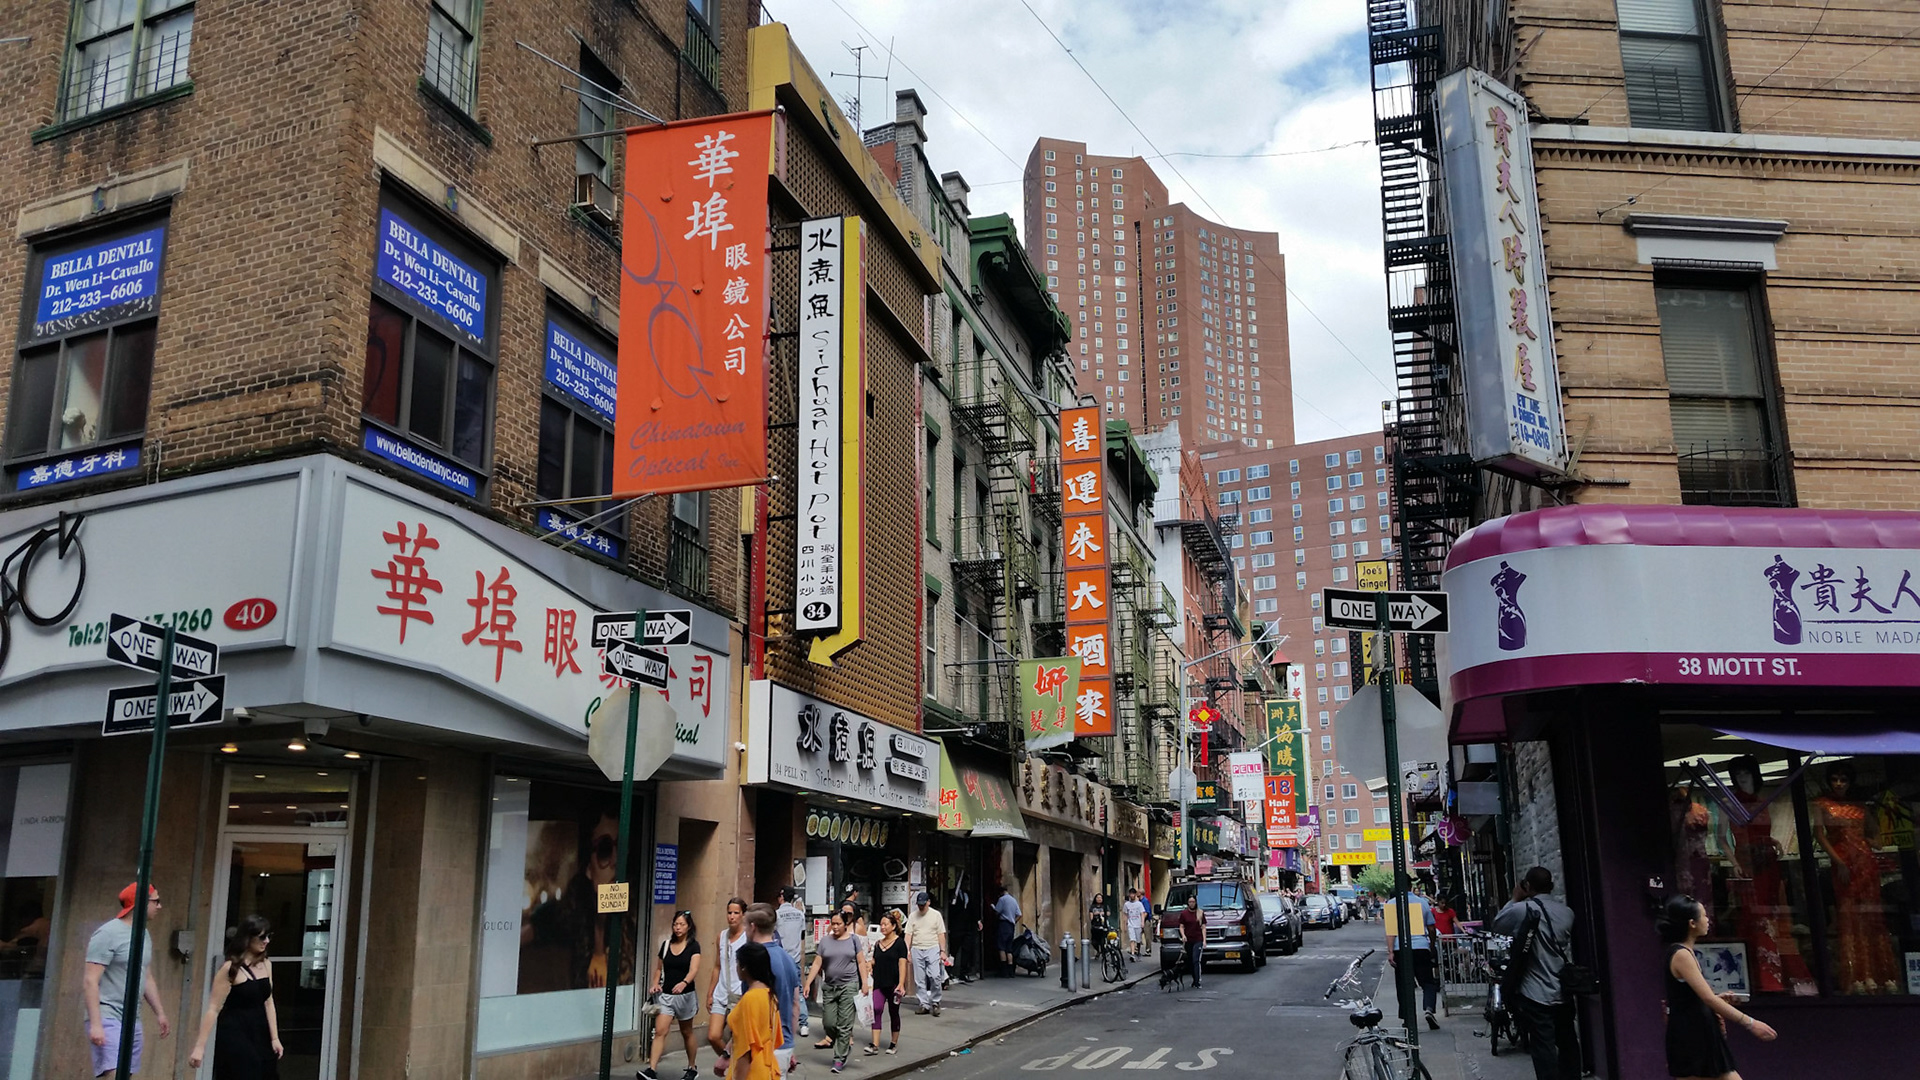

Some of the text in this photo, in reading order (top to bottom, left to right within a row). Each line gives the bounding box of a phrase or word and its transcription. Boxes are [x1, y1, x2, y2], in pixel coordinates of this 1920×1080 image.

[51, 238, 153, 279] BELLA DENTAL
[384, 240, 401, 262] Dr.
[403, 252, 427, 279] Wen
[388, 219, 480, 293] BELLA DENTAL
[807, 226, 838, 321] 水煮魚
[45, 285, 61, 298] Dr.
[65, 278, 89, 293] Wen
[51, 279, 143, 315] 212-233-6606
[392, 265, 474, 327] 212-233-6606
[722, 242, 751, 376] 眼鏡公司
[553, 330, 582, 361] BELLA
[550, 347, 562, 364] Dr.
[563, 356, 581, 378] Wen
[556, 368, 614, 415] 212-233-6606
[630, 420, 747, 450] Chinatown
[808, 330, 830, 540] Sichuan Hot Pot
[30, 449, 126, 484] 嘉德牙科
[376, 434, 469, 489] www.belladentalnyc.com
[629, 448, 710, 484] Optical
[1362, 565, 1382, 576] Joe's
[1359, 579, 1387, 590] Ginger
[1801, 564, 1920, 614] 貴夫人
[235, 602, 265, 625] 40
[807, 603, 826, 619] 34
[1341, 602, 1428, 620] ONE WAY
[600, 622, 677, 637] ONE WAY
[1809, 631, 1862, 644] NOBLE
[120, 631, 207, 669] ONE WAY
[614, 651, 664, 677] ONE WAY
[1678, 657, 1802, 676] 38 MOTT ST.
[123, 692, 207, 718] ONE WAY
[784, 765, 798, 779] PELL
[1232, 763, 1262, 774] PELL
[1267, 780, 1291, 795] 18
[1268, 799, 1290, 807] Hair
[1271, 816, 1290, 824] Pell
[600, 892, 627, 900] PARKING
[601, 901, 626, 909] SUNDAY
[483, 921, 512, 930] GUCCI
[1020, 1046, 1234, 1071] STOP
